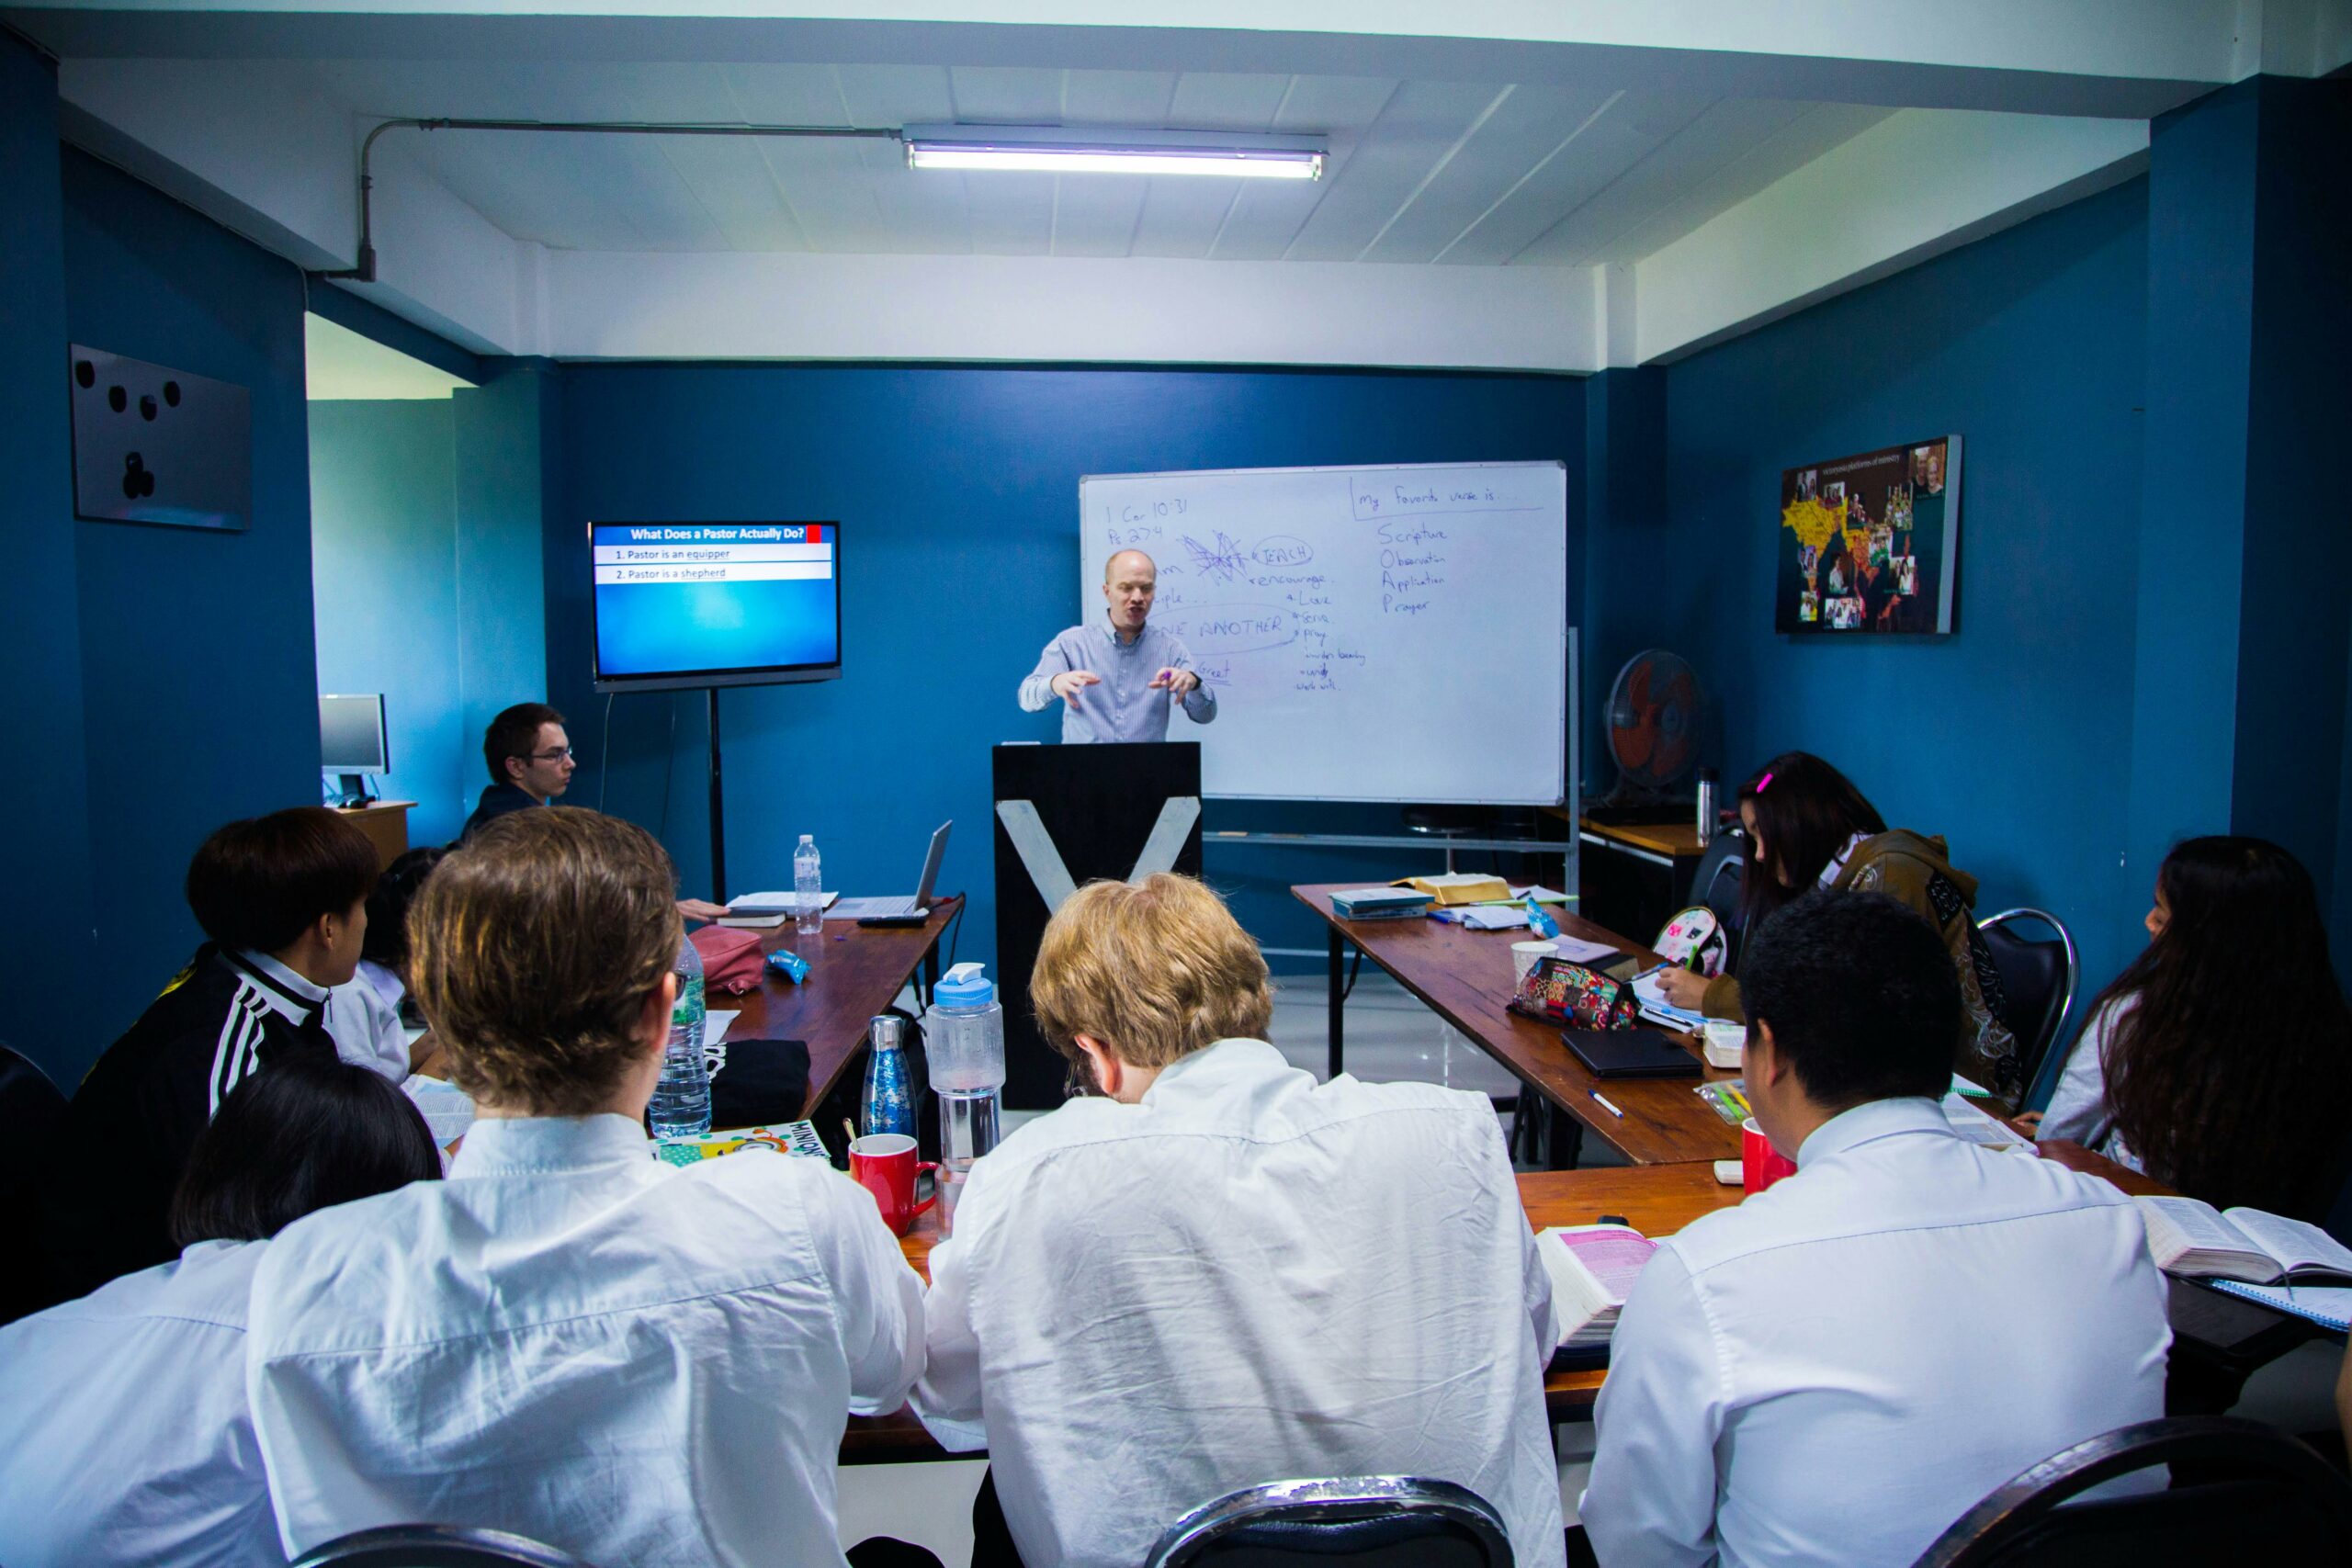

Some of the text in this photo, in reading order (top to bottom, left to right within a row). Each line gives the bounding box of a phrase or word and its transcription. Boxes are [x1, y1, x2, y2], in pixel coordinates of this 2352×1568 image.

[630, 527, 804, 541] What Does a Pastor Actually Do?
[1378, 524, 1448, 545] Scripture
[616, 550, 625, 559] 1.
[628, 550, 659, 559] Pastor
[662, 549, 669, 558] is
[686, 549, 730, 559] equipper
[1263, 546, 1306, 565] TEACH
[616, 570, 625, 579] 2.
[628, 570, 659, 579] Pastor
[662, 569, 670, 578] is
[681, 568, 726, 579] shepherd
[1200, 615, 1282, 637] ANOTHER
